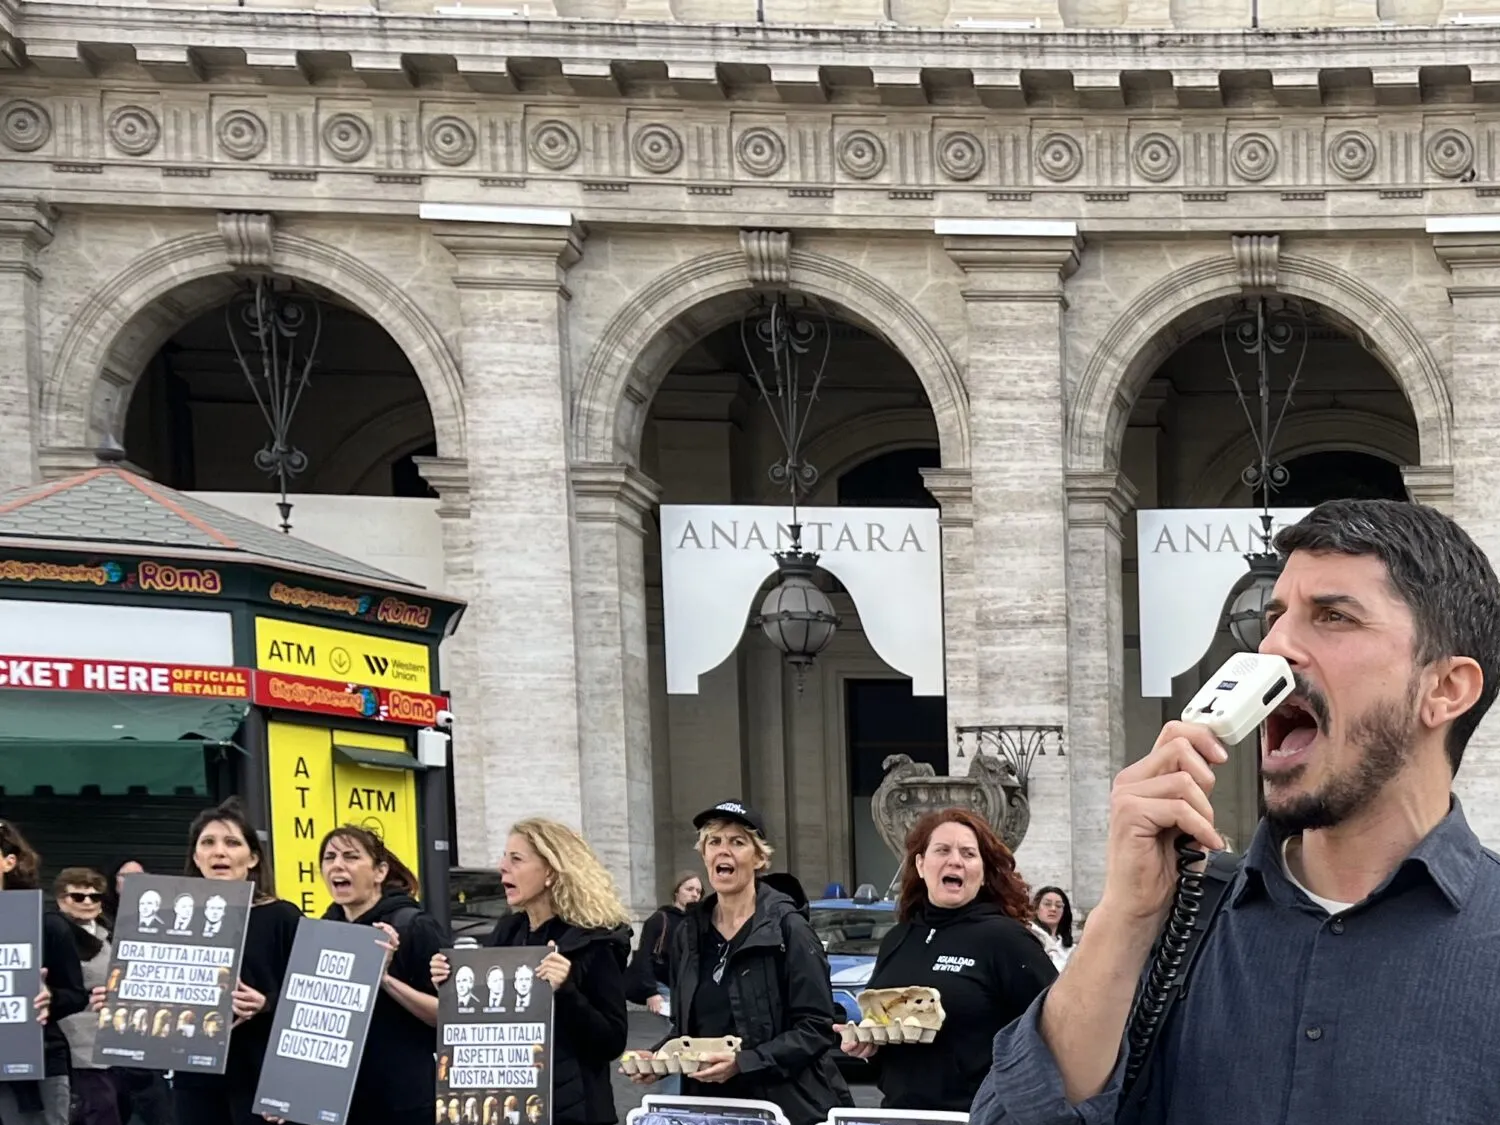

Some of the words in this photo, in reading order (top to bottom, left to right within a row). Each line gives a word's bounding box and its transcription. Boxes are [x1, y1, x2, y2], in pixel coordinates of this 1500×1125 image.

[676, 519, 926, 552] ANANTARA
[1151, 523, 1292, 553] ANAN
[268, 639, 316, 667] ATM
[172, 668, 246, 684] OFFICIAL
[392, 659, 426, 674] Western
[392, 671, 417, 683] Union
[83, 664, 170, 693] HERE
[173, 682, 247, 697] RETAILER
[294, 756, 315, 840] ATM
[348, 787, 397, 813] ATM
[121, 944, 146, 958] ORA
[151, 945, 188, 961] TUTTA
[192, 948, 231, 964] ITALIA
[319, 953, 350, 976] OGGI
[130, 964, 186, 981] ASPETTA
[189, 967, 215, 983] UNA
[123, 983, 172, 999] VOSTRA
[174, 986, 217, 1003] MOSSA
[290, 977, 364, 1009] IMMONDIZIA,
[295, 1006, 347, 1035] QUANDO
[446, 1027, 467, 1042] ORA
[471, 1027, 505, 1042] TUTTA
[508, 1025, 543, 1042] ITALIA
[280, 1034, 349, 1064] GIUSTIZIA?
[456, 1048, 505, 1064] ASPETTA
[507, 1047, 530, 1063] UNA
[452, 1069, 495, 1086] VOSTRA
[497, 1068, 535, 1085] MOSSA
